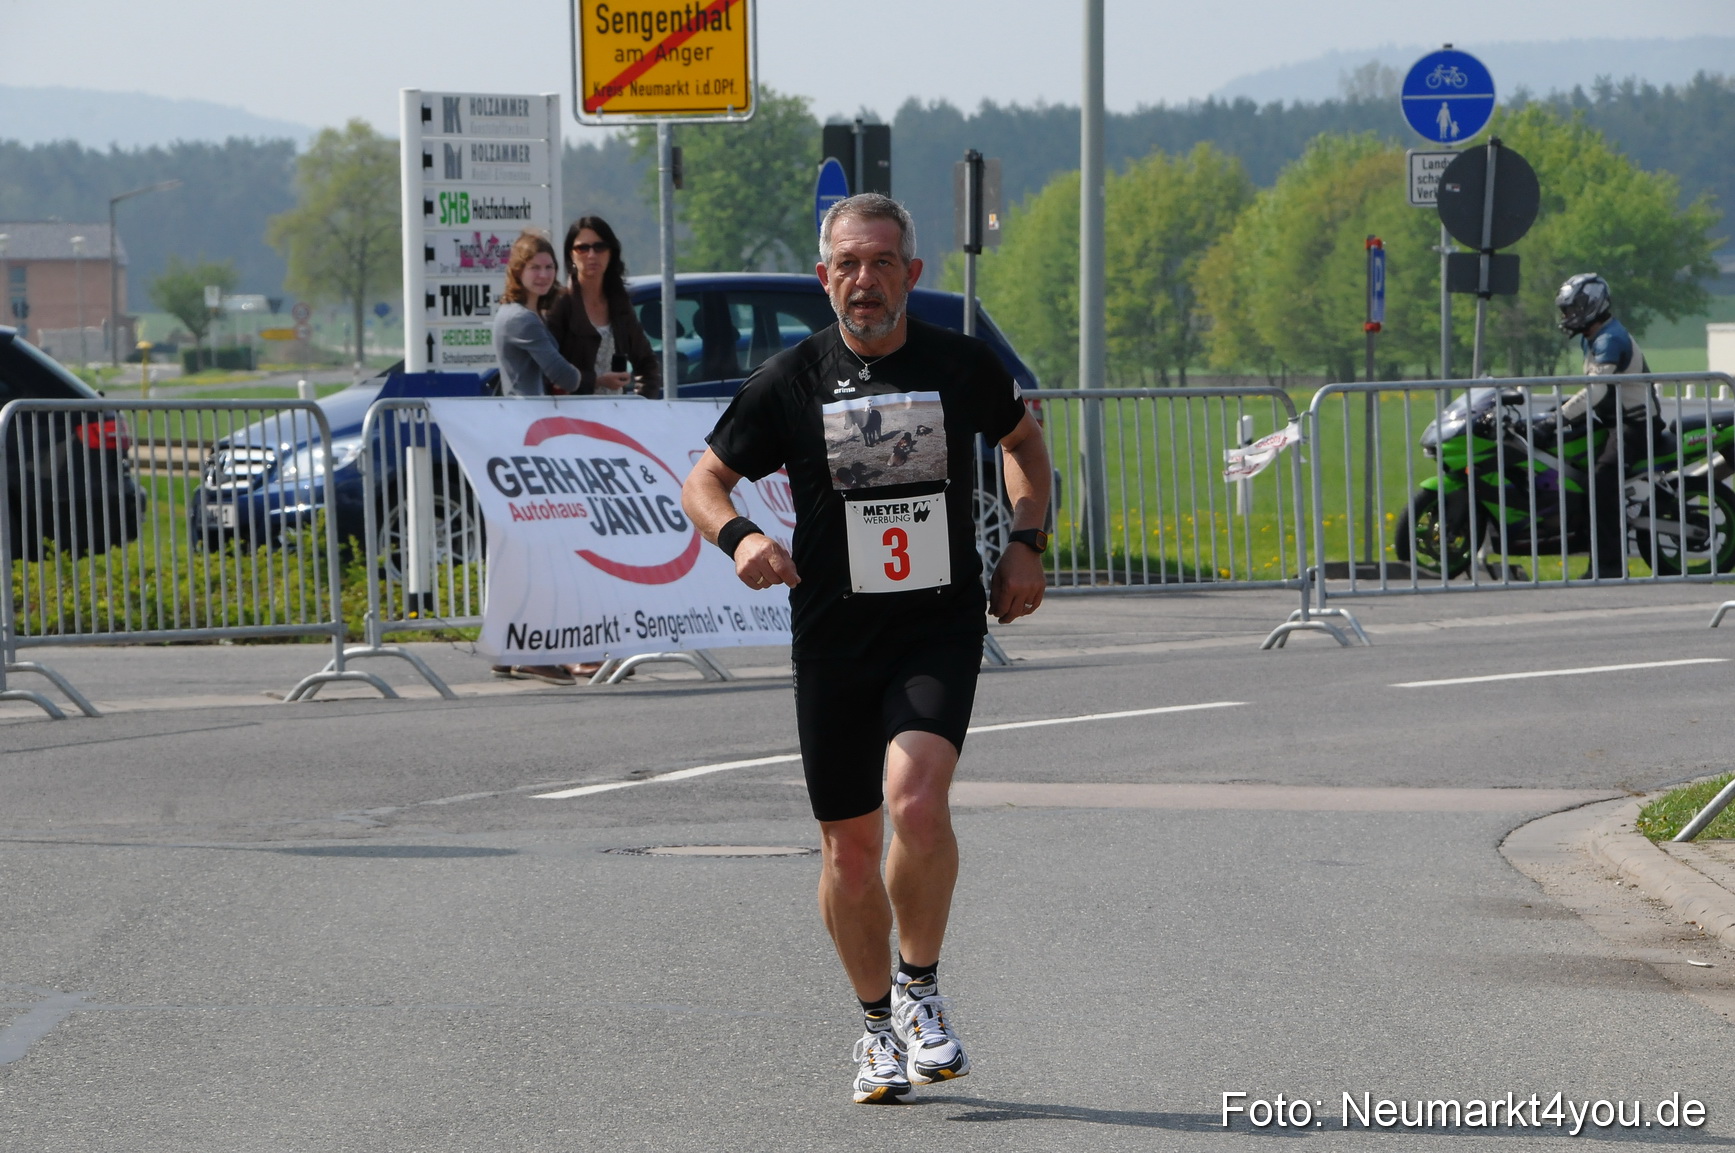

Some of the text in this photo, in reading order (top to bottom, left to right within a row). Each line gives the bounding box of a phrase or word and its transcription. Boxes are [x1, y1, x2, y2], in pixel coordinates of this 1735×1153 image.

[596, 1, 732, 42] Sengenthal
[614, 43, 714, 66] am Anger
[593, 82, 624, 97] Kreis
[630, 81, 690, 97] Neumarkt
[469, 97, 530, 117] HOLZAMMER
[471, 144, 531, 163] HOLZAMMER
[1417, 173, 1440, 185] scha
[439, 191, 470, 226] SHB
[440, 284, 491, 316] THULE
[442, 328, 493, 346] HEIDELBER
[487, 456, 657, 498] GERHART &
[508, 494, 688, 536] Autohaus JÄNIG
[863, 503, 910, 516] MEYER
[863, 514, 911, 524] WERBUNG
[882, 527, 911, 581] 3
[506, 614, 621, 651] Neumarkt
[635, 605, 719, 643] Sengenthal
